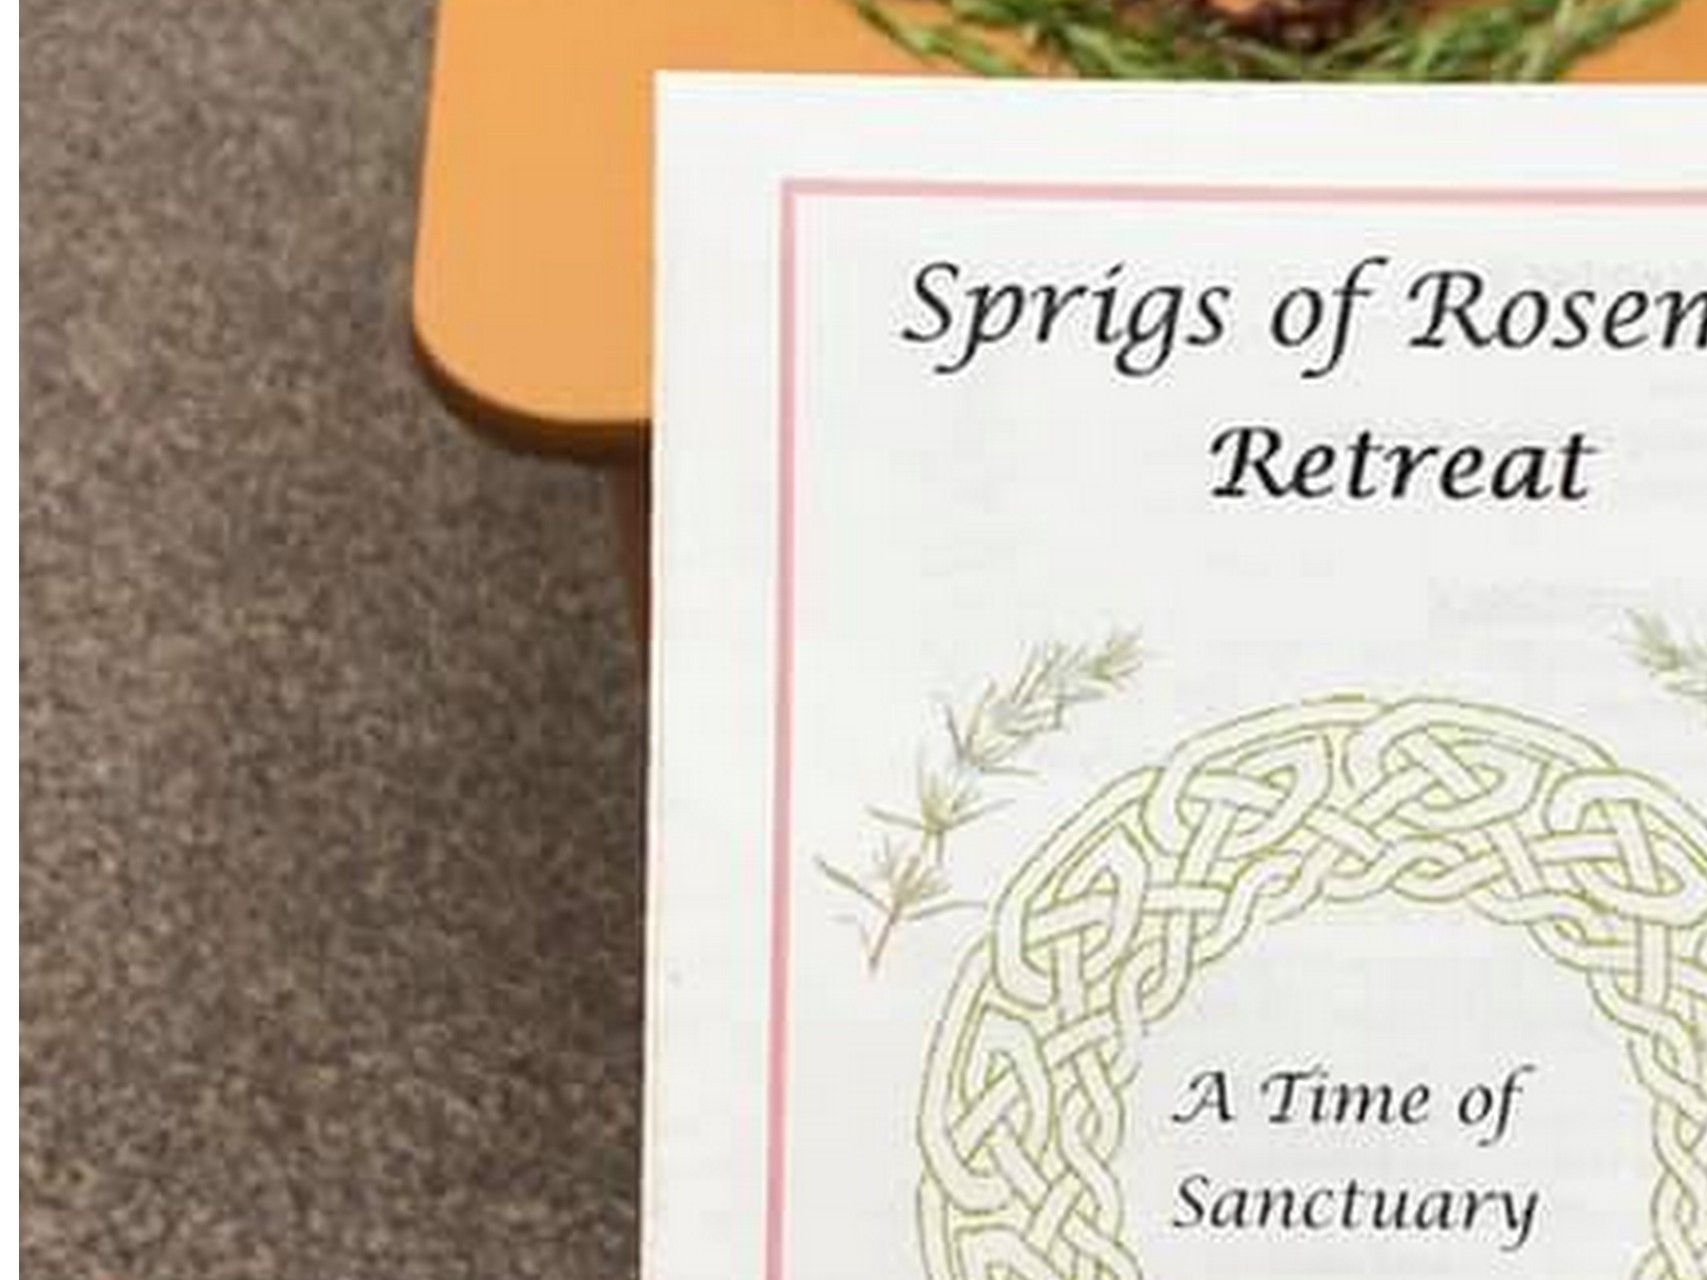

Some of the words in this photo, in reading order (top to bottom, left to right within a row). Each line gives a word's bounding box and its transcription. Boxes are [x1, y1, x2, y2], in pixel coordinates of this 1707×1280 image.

[900, 260, 1230, 379] Sprigs
[1269, 256, 1389, 380] of
[1210, 426, 1596, 501] Retreat
[1170, 1069, 1235, 1124] A
[1259, 1063, 1430, 1125] Time
[1457, 1064, 1536, 1148] of
[1171, 1174, 1540, 1251] Sanctuary
